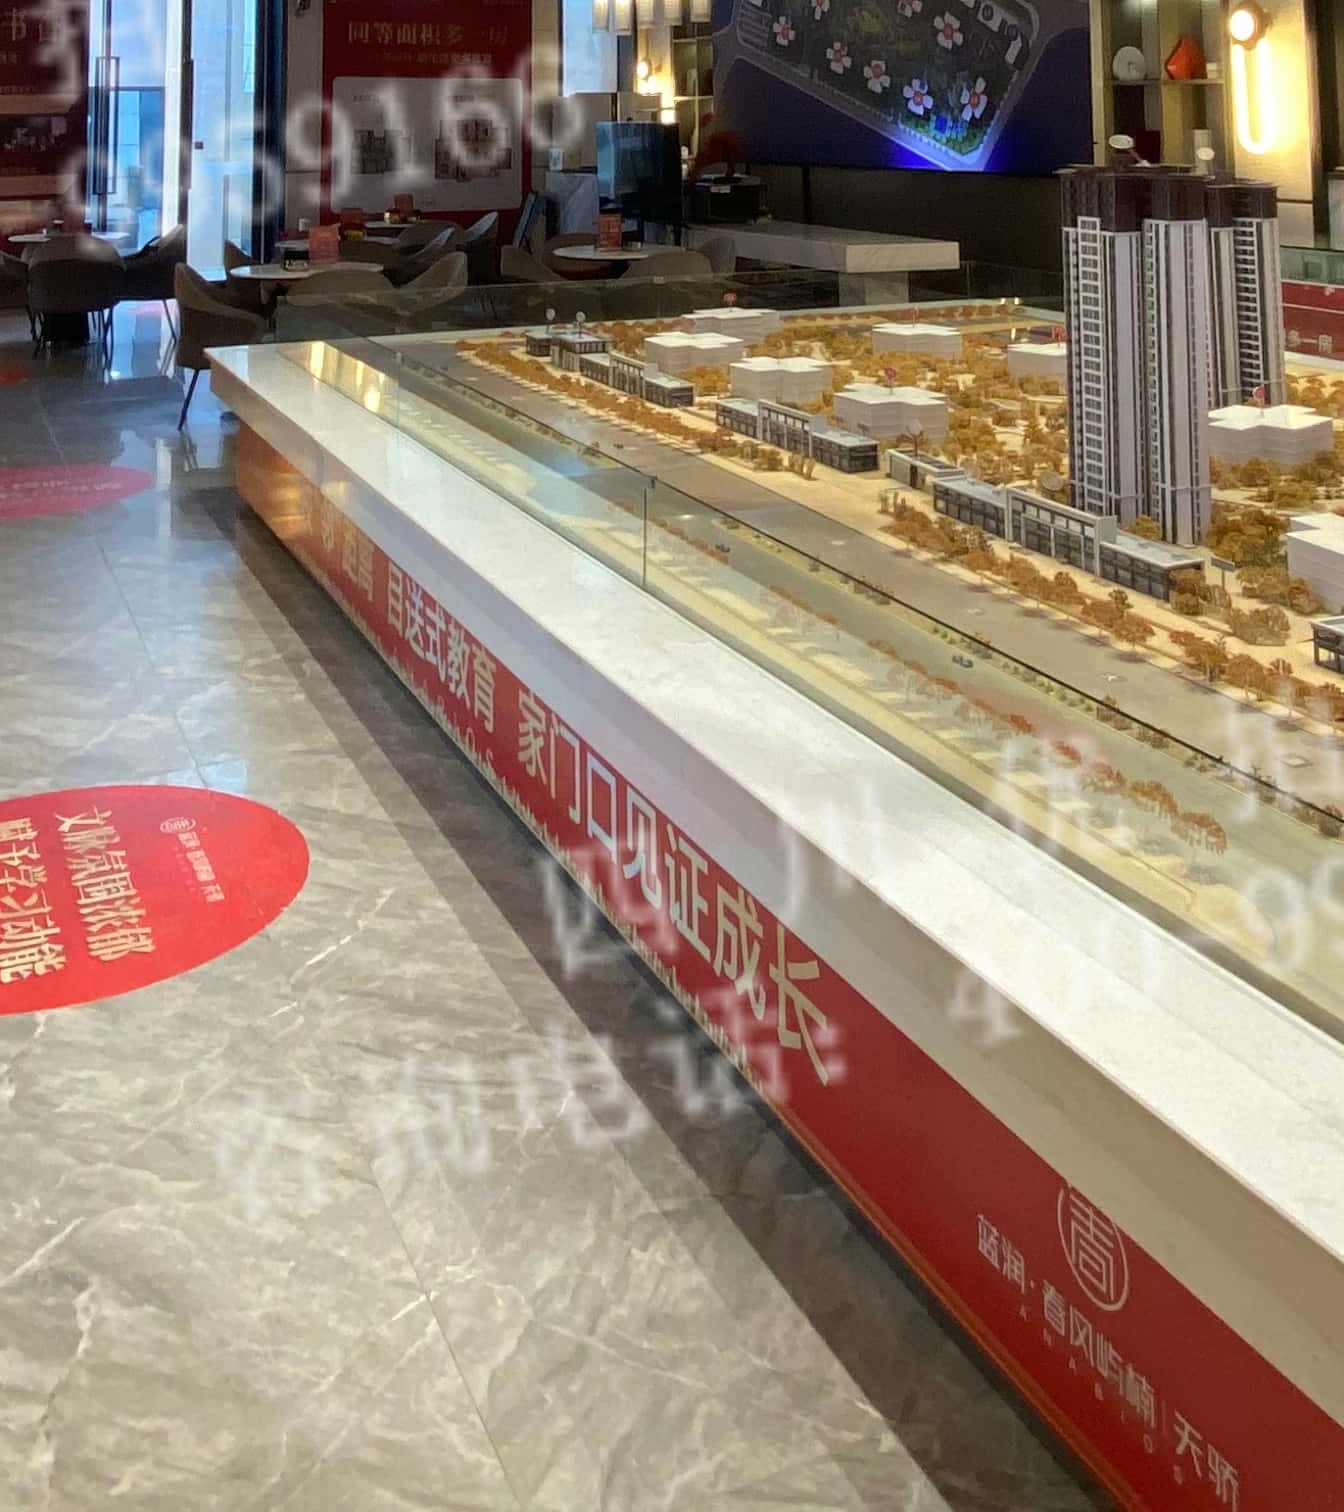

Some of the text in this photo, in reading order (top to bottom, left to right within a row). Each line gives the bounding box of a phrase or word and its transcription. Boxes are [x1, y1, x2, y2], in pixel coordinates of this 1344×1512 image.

[55, 805, 156, 962] 文脉氛围浓郁
[387, 556, 832, 1086] 目送式教育 家门口见证成长
[1173, 1410, 1241, 1512] 天骄
